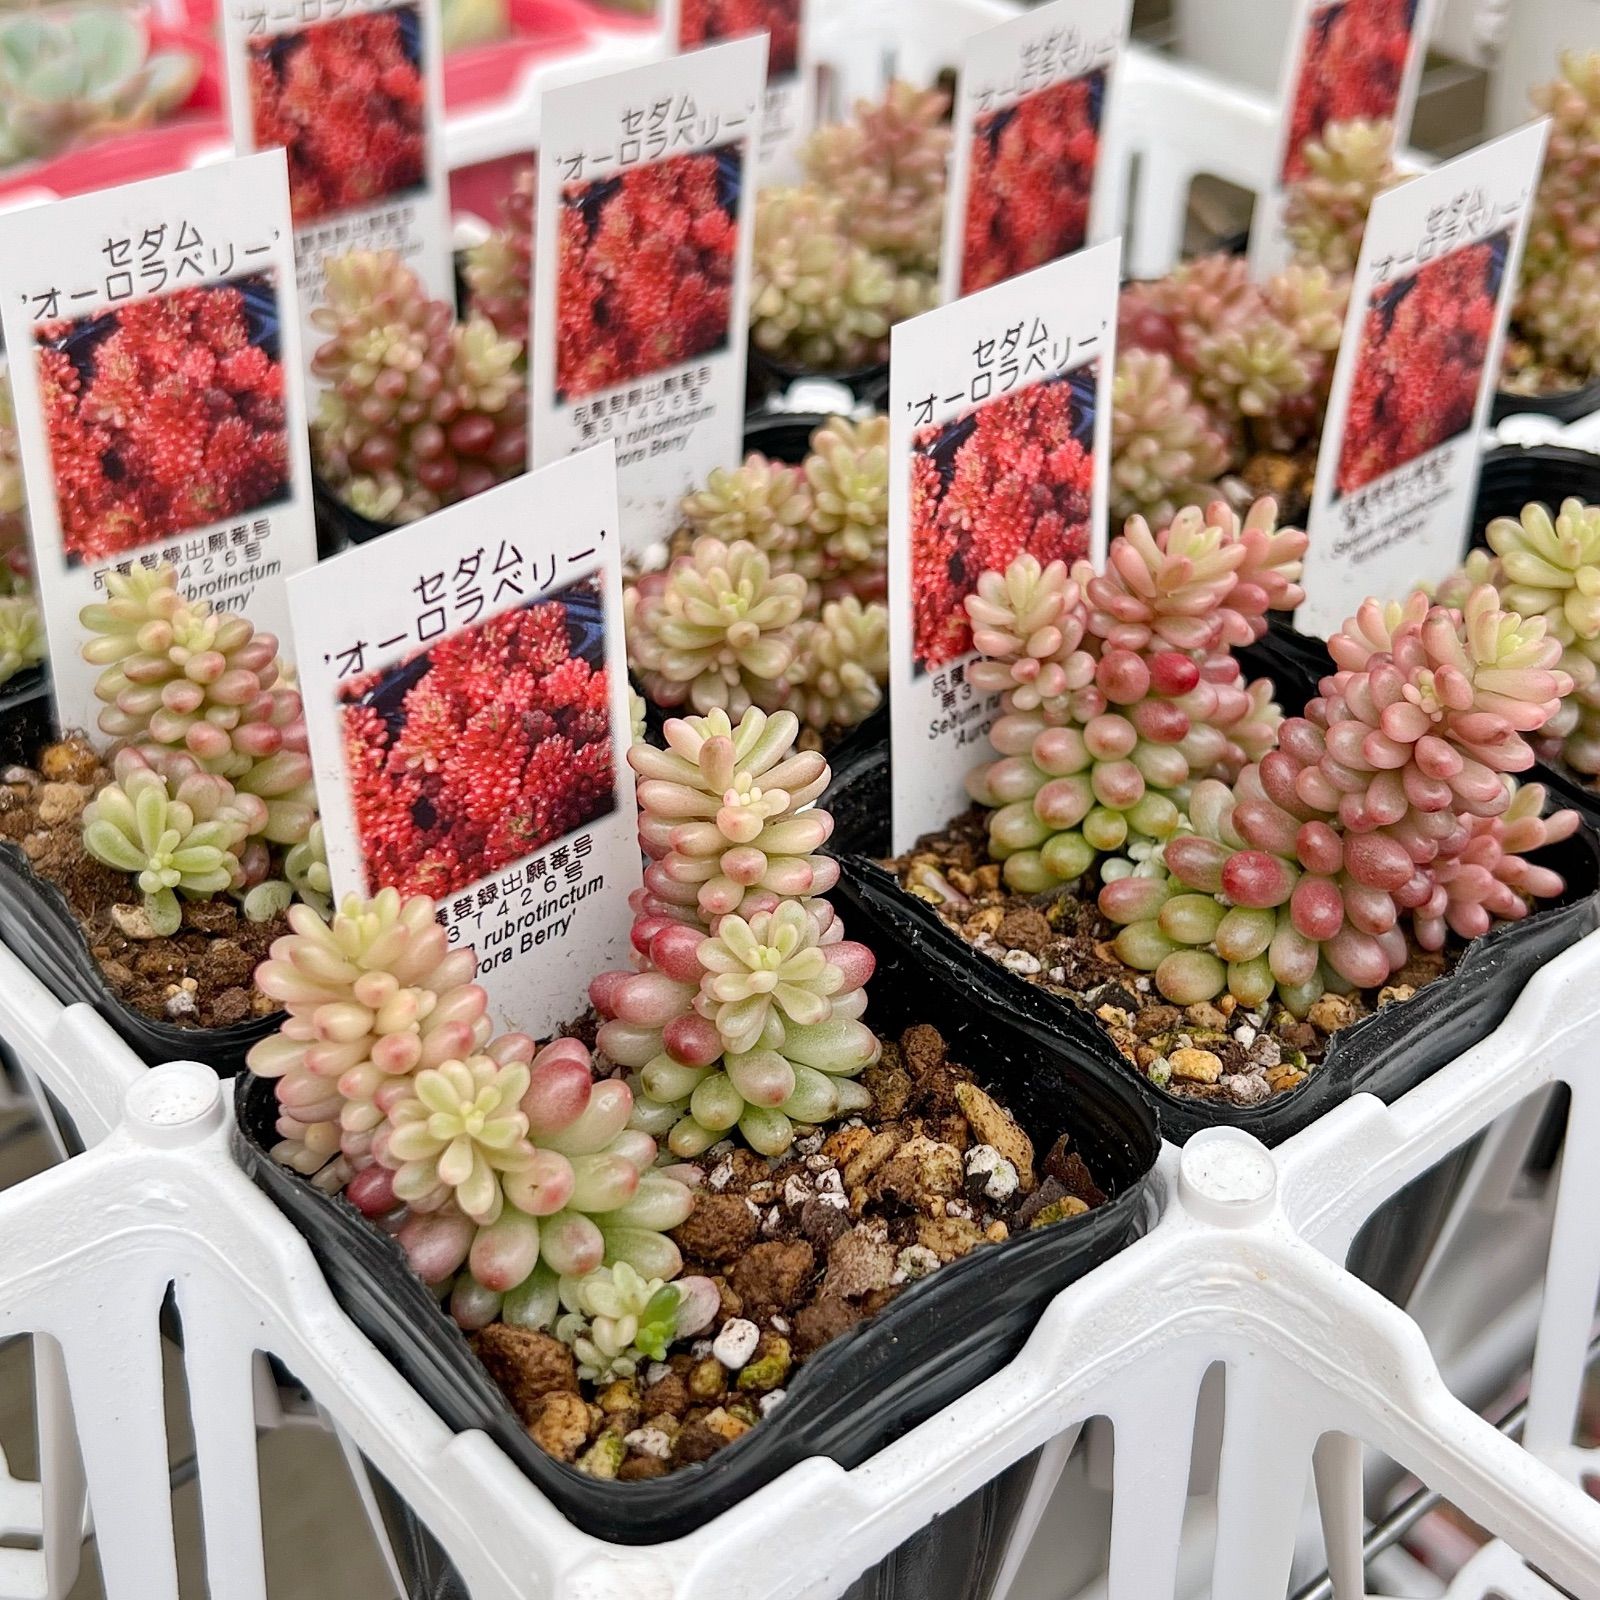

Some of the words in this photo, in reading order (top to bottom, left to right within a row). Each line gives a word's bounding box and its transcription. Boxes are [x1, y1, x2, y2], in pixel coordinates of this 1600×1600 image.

[621, 94, 697, 136] セダム
[102, 220, 203, 267] セダム
[973, 317, 1048, 368] セダム
[616, 447, 647, 468] rora
[178, 560, 281, 602] brotinctum
[413, 540, 523, 604] セダム
[435, 834, 593, 927] 種登録出願番号
[448, 860, 583, 943] 37426号
[485, 875, 604, 950] rubrotinctum
[474, 947, 512, 979] rora
[521, 908, 576, 954] Berry'
